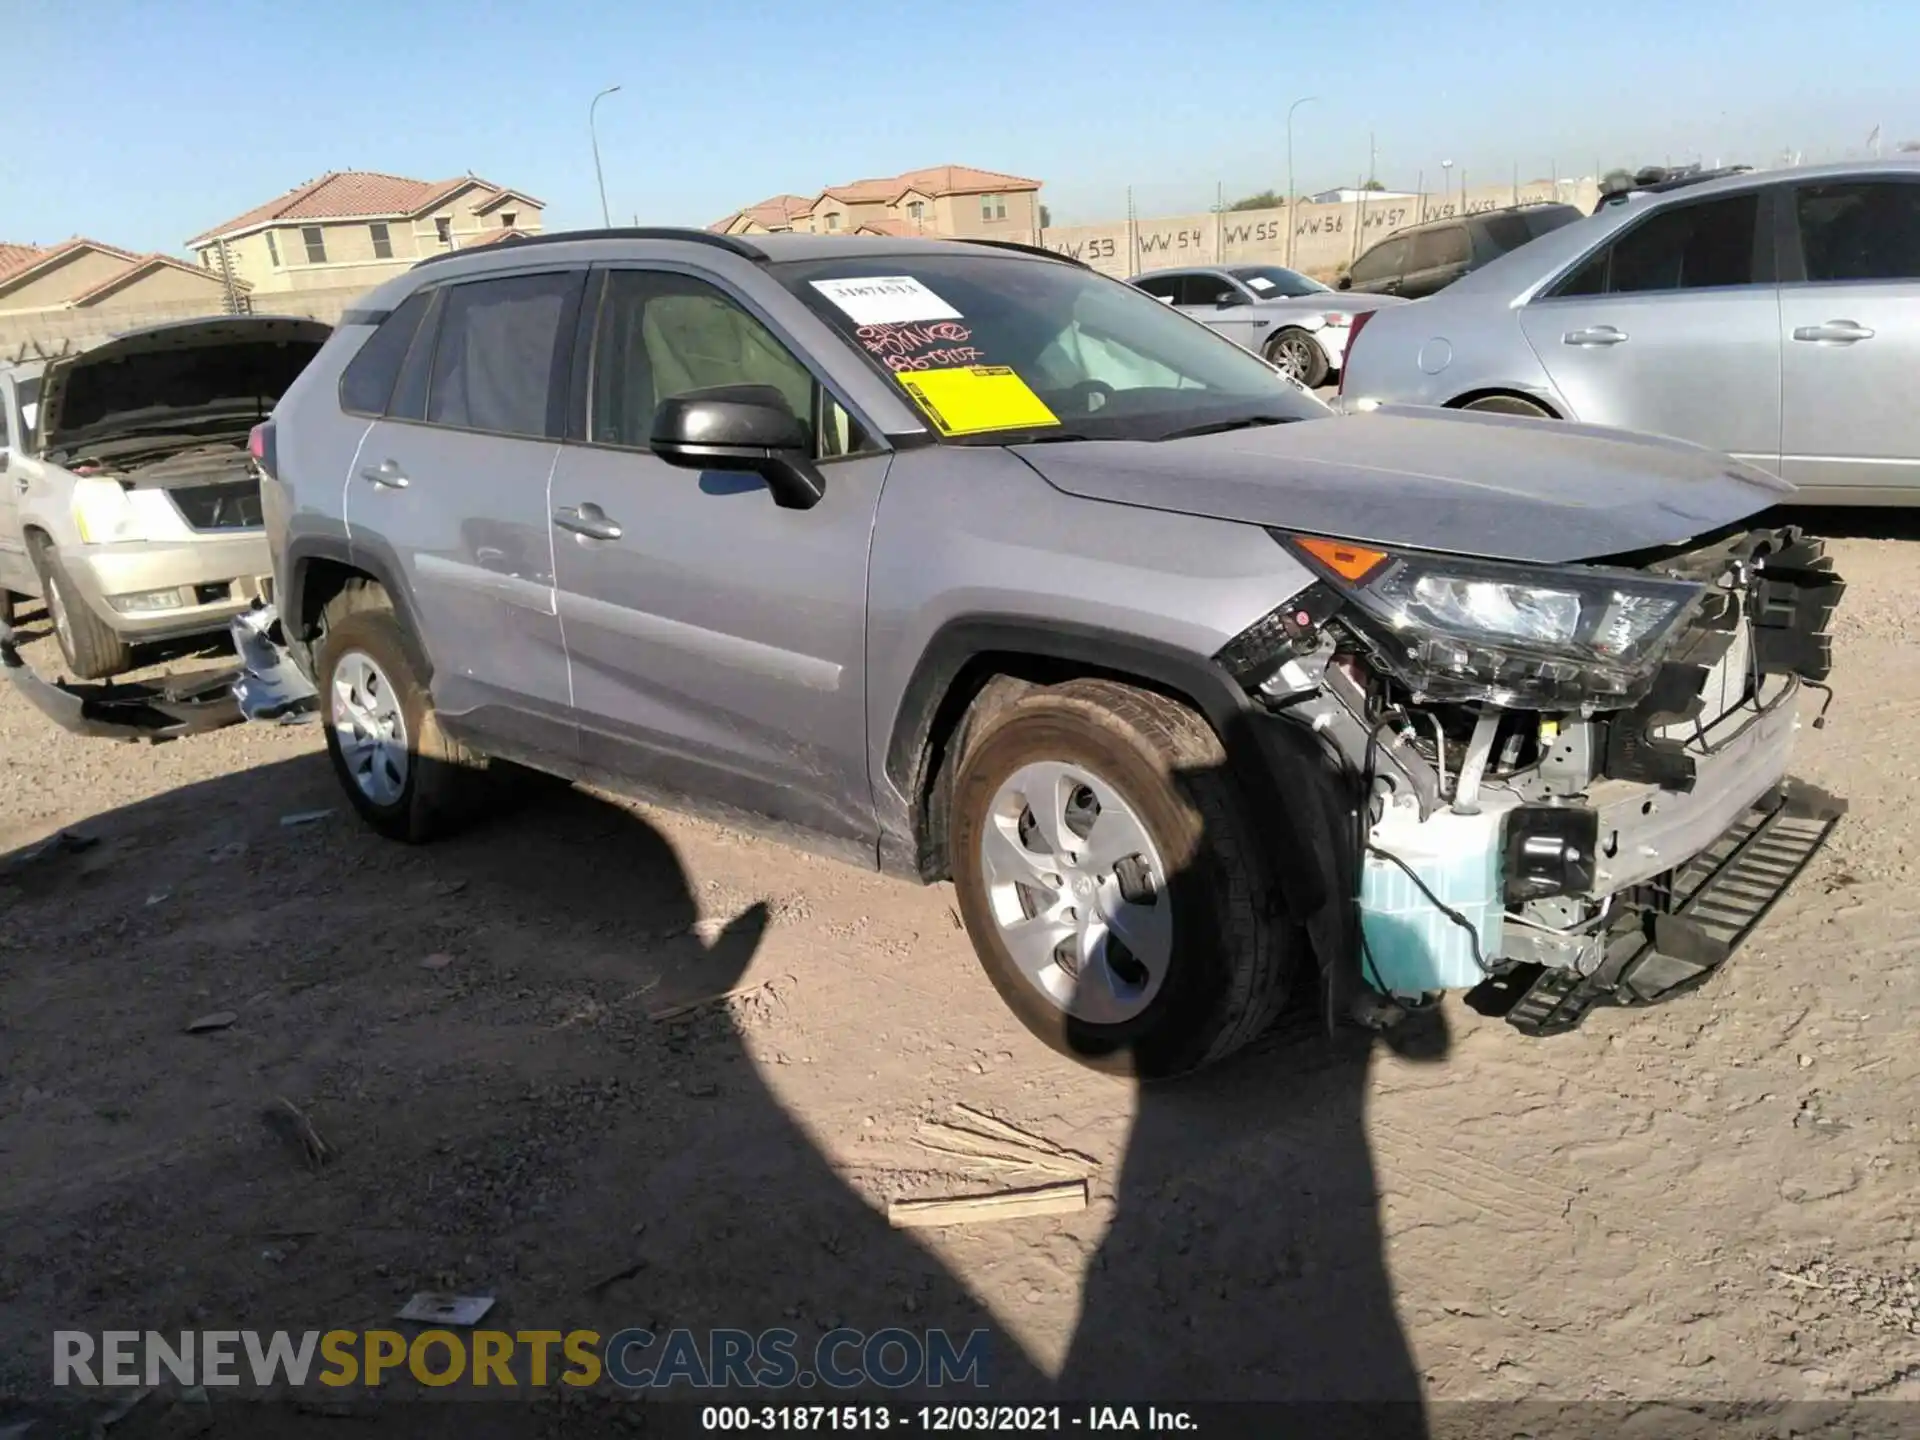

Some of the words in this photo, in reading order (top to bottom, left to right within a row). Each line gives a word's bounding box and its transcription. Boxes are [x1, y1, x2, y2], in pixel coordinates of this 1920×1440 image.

[1296, 218, 1321, 236] WW
[1325, 215, 1343, 233] 56
[1388, 209, 1406, 226] 57
[1139, 233, 1171, 253] WW
[1177, 231, 1201, 249] 54
[1224, 222, 1252, 244] WW
[1256, 221, 1279, 241] 55
[1088, 238, 1115, 259] 53
